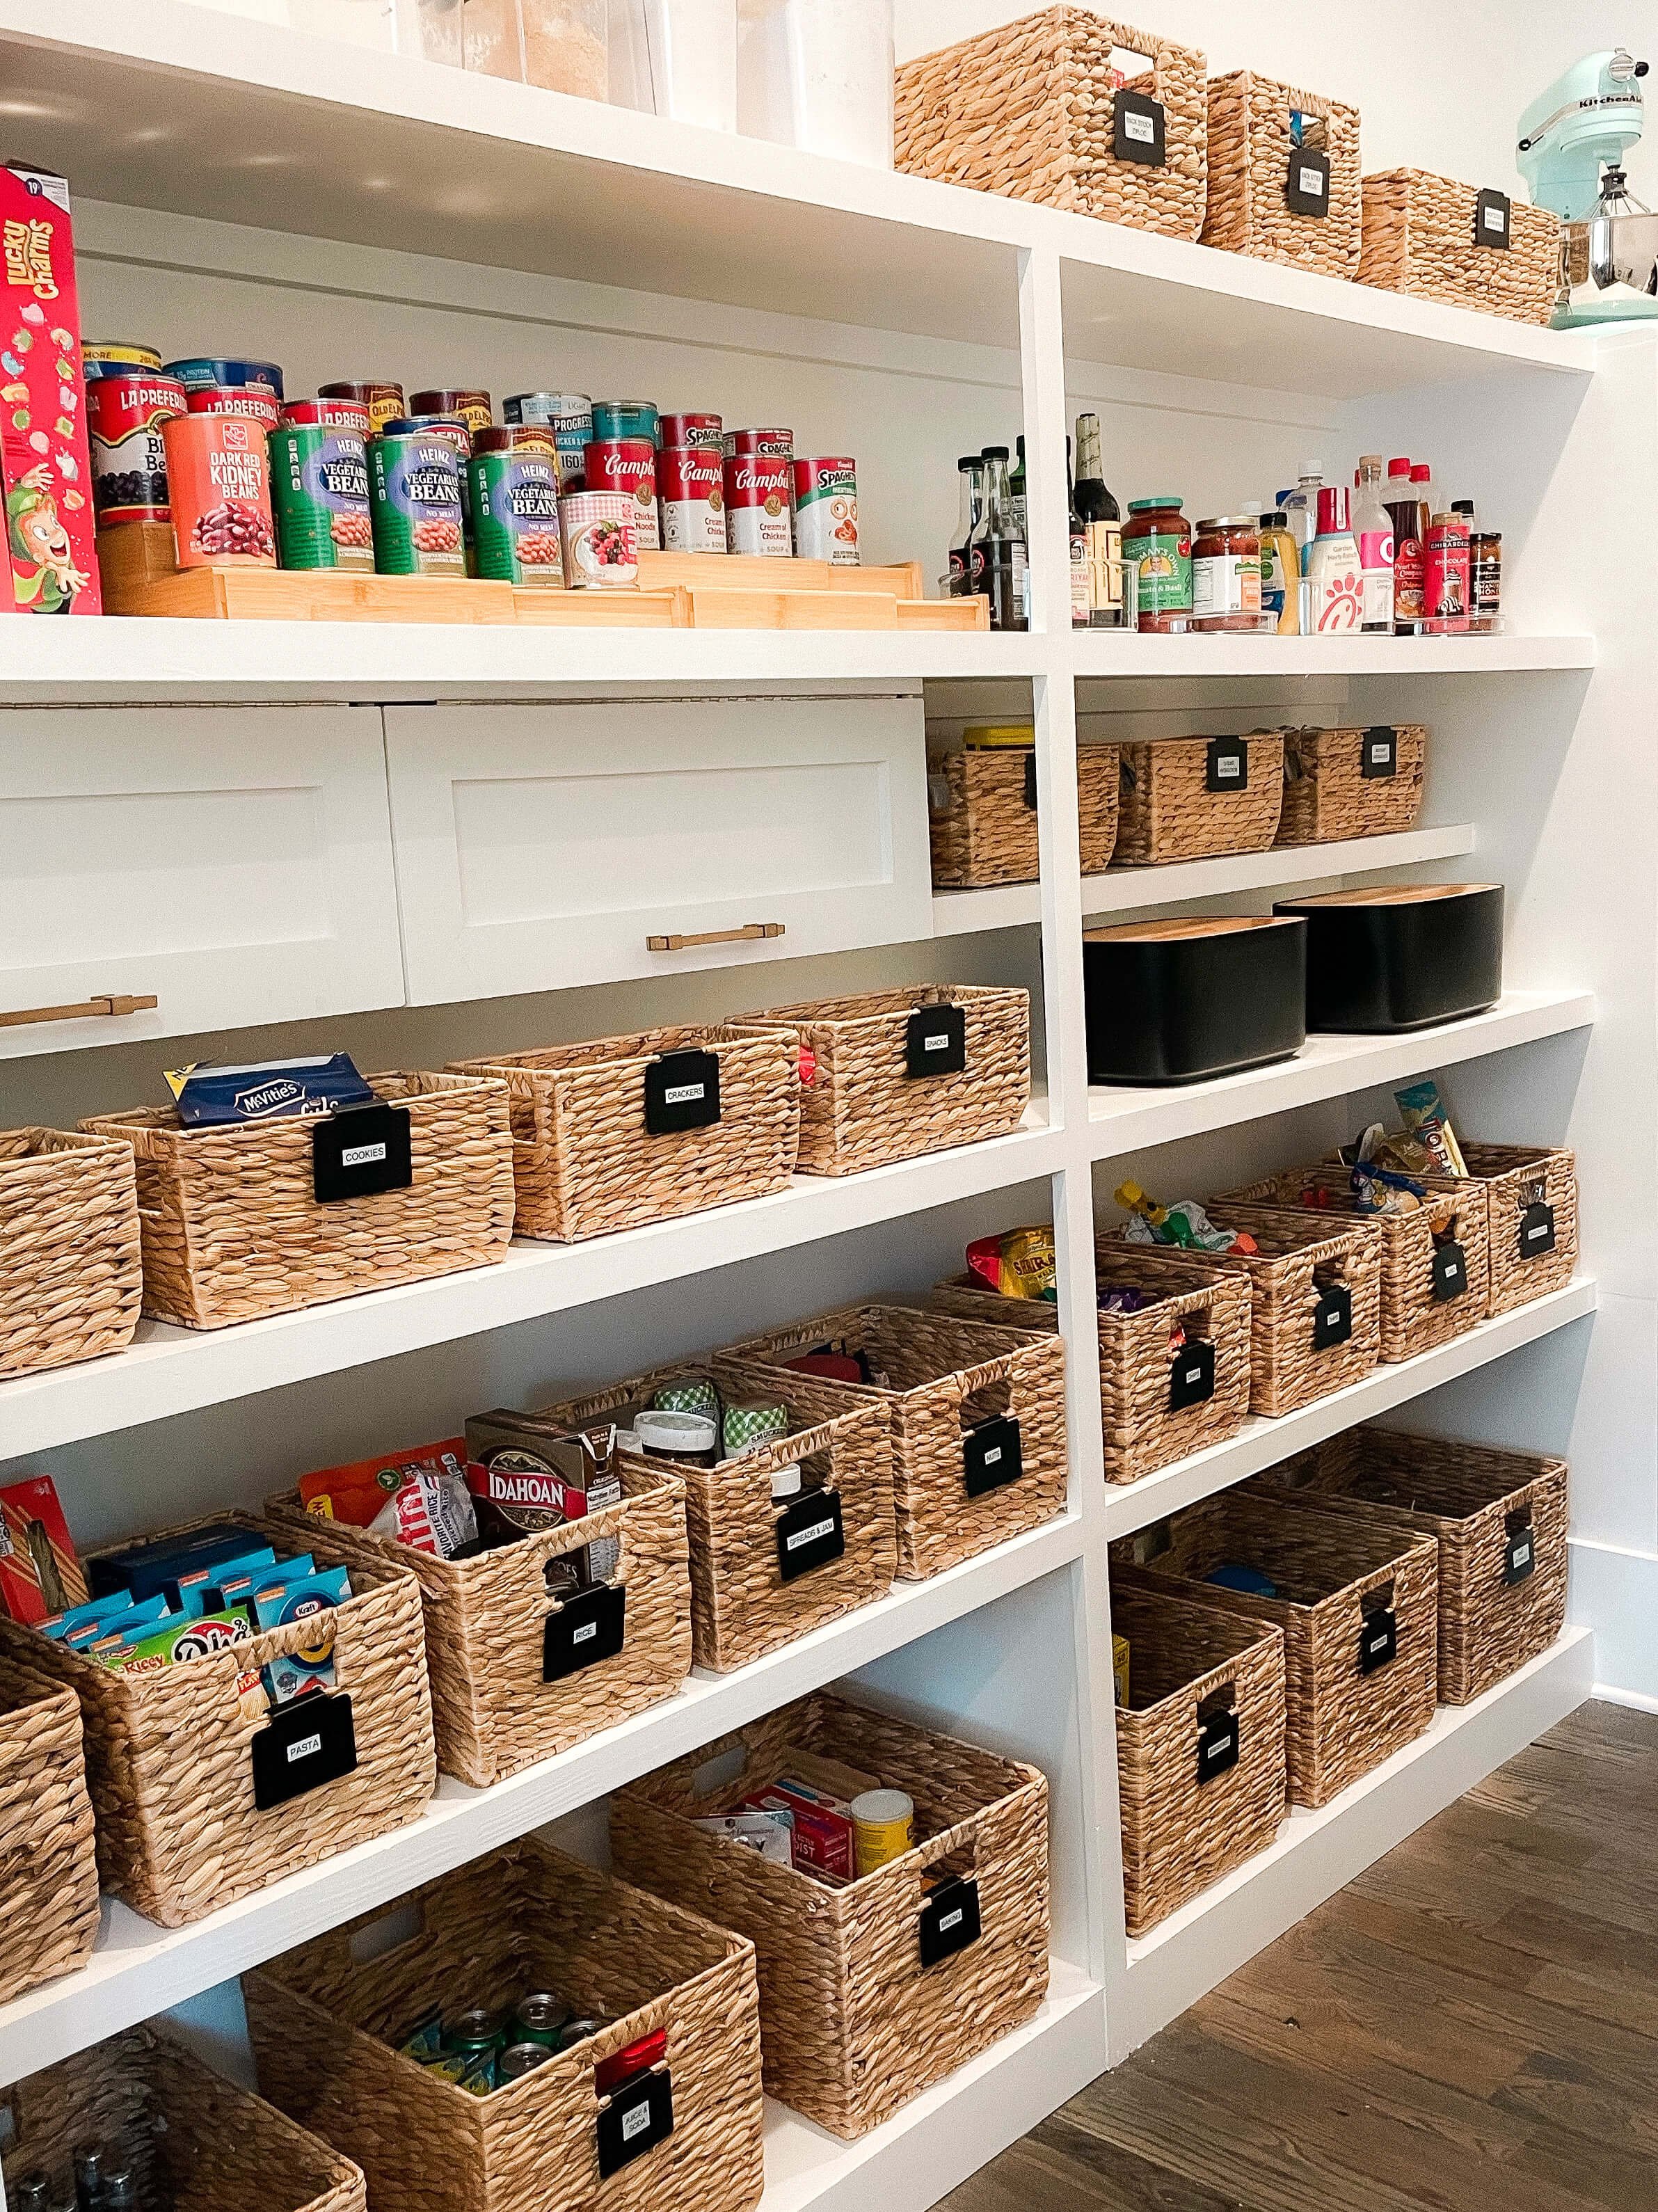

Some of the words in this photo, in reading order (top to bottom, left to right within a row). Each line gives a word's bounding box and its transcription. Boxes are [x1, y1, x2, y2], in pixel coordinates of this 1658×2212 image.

[120, 390, 138, 411] LA
[687, 428, 722, 445] SPAGHE
[210, 452, 242, 467] DARK
[244, 454, 261, 468] RED
[419, 449, 450, 465] HEINZ
[210, 466, 262, 487] KIDNEY
[521, 466, 550, 481] HEINZ
[819, 471, 856, 488] SPAGHE
[222, 485, 260, 500] BEANS
[409, 485, 460, 503] BEANS
[927, 1037, 947, 1047] SNACKS
[244, 1083, 298, 1112] McVitie's
[667, 1087, 703, 1100] CRACKERS
[345, 1147, 385, 1161] COOKIES
[488, 1472, 564, 1509] IDAHOAN
[790, 1529, 816, 1547] SPREADS
[298, 1602, 317, 1616] Kraft
[576, 1626, 592, 1639] RICE
[289, 1739, 319, 1758] PASTA
